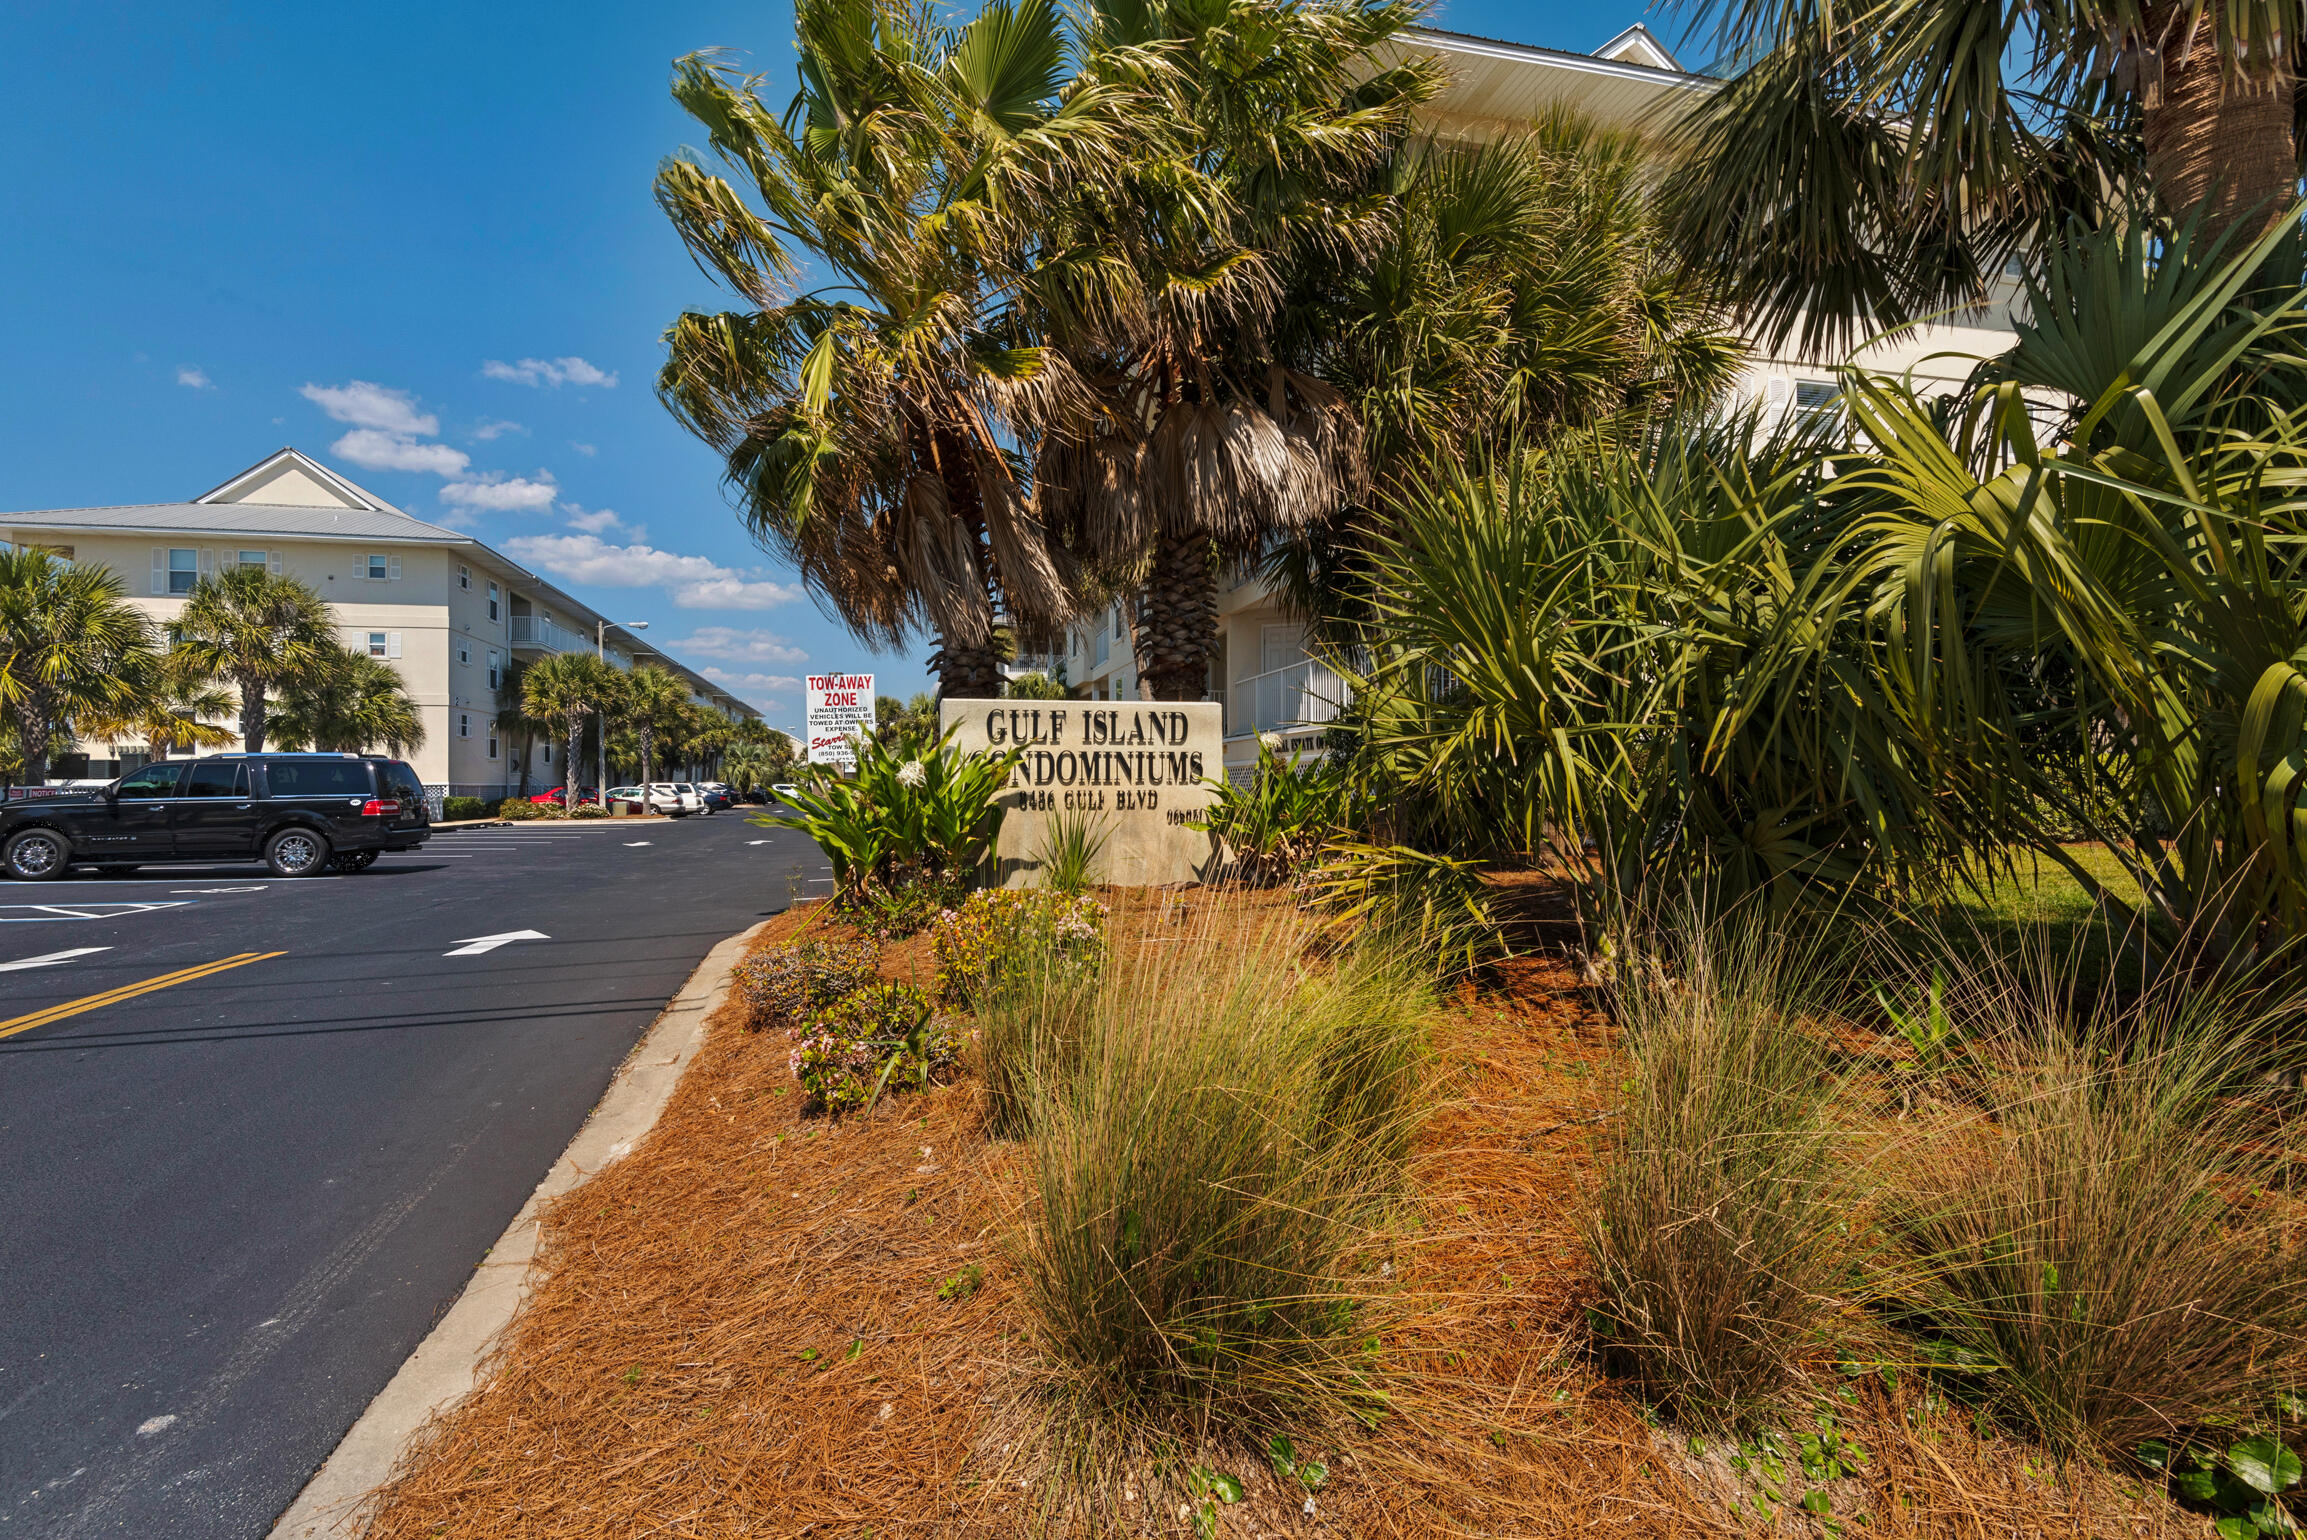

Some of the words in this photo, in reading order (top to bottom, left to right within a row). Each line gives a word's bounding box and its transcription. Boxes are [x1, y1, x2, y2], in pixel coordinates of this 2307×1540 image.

[808, 676, 872, 690] TOW-AWAY
[824, 692, 857, 707] ZONE
[986, 708, 1067, 746] GULF
[1082, 709, 1189, 746] ISLAND
[1116, 789, 1159, 811] BLVD
